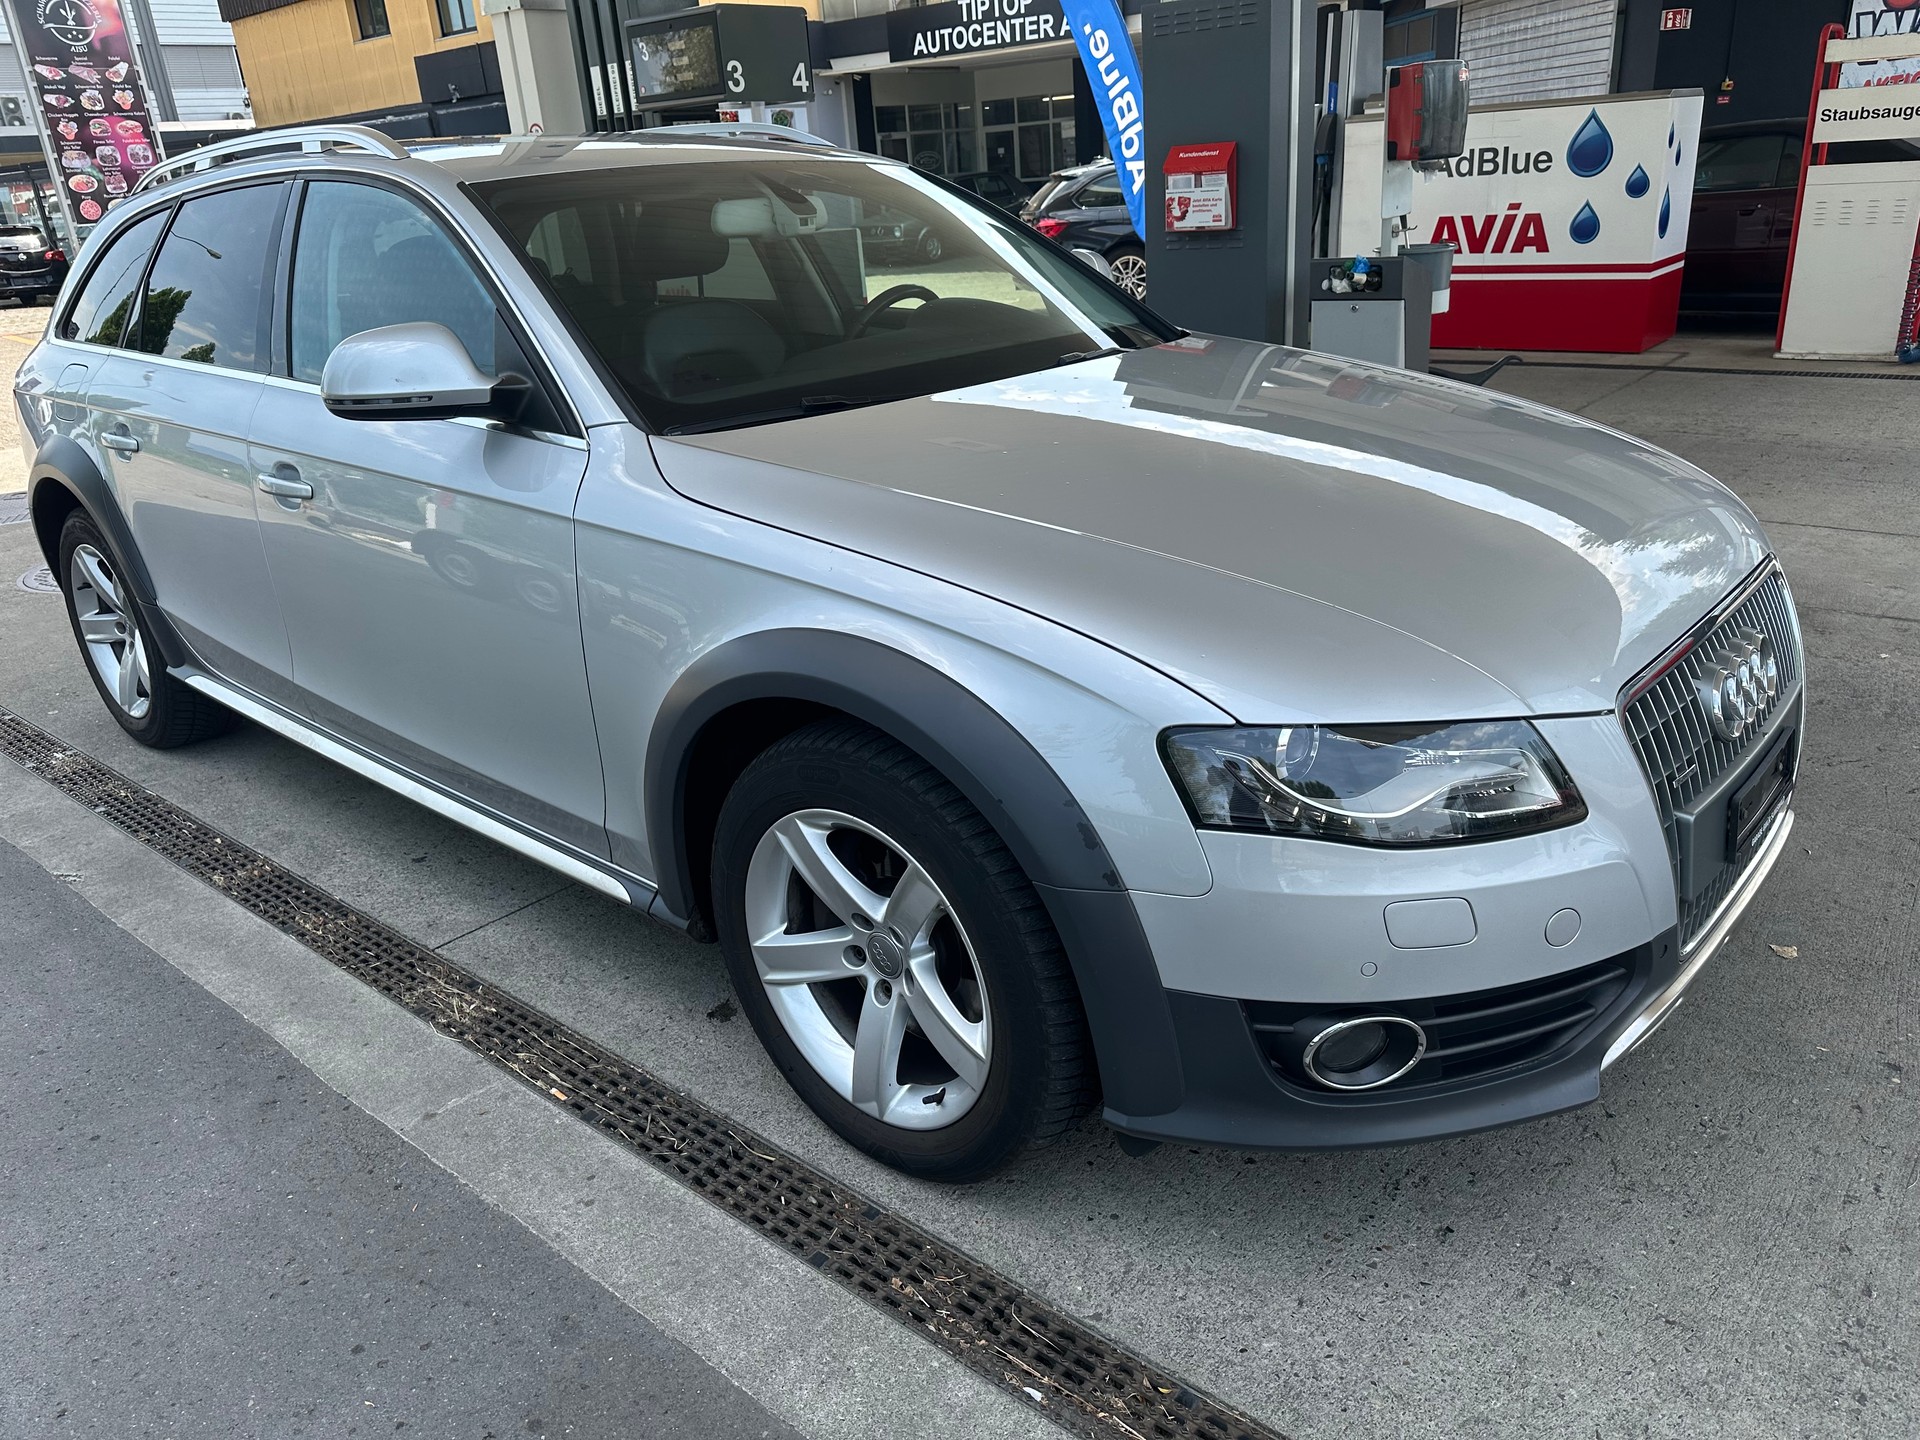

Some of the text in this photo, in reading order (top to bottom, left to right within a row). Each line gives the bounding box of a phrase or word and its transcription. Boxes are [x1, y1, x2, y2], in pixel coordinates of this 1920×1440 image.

[958, 0, 1033, 22] TIPTOP
[913, 14, 1056, 56] AUTOCENTER
[639, 42, 649, 61] 3
[727, 60, 810, 93] 3 4
[1179, 150, 1219, 158] Kundendienst
